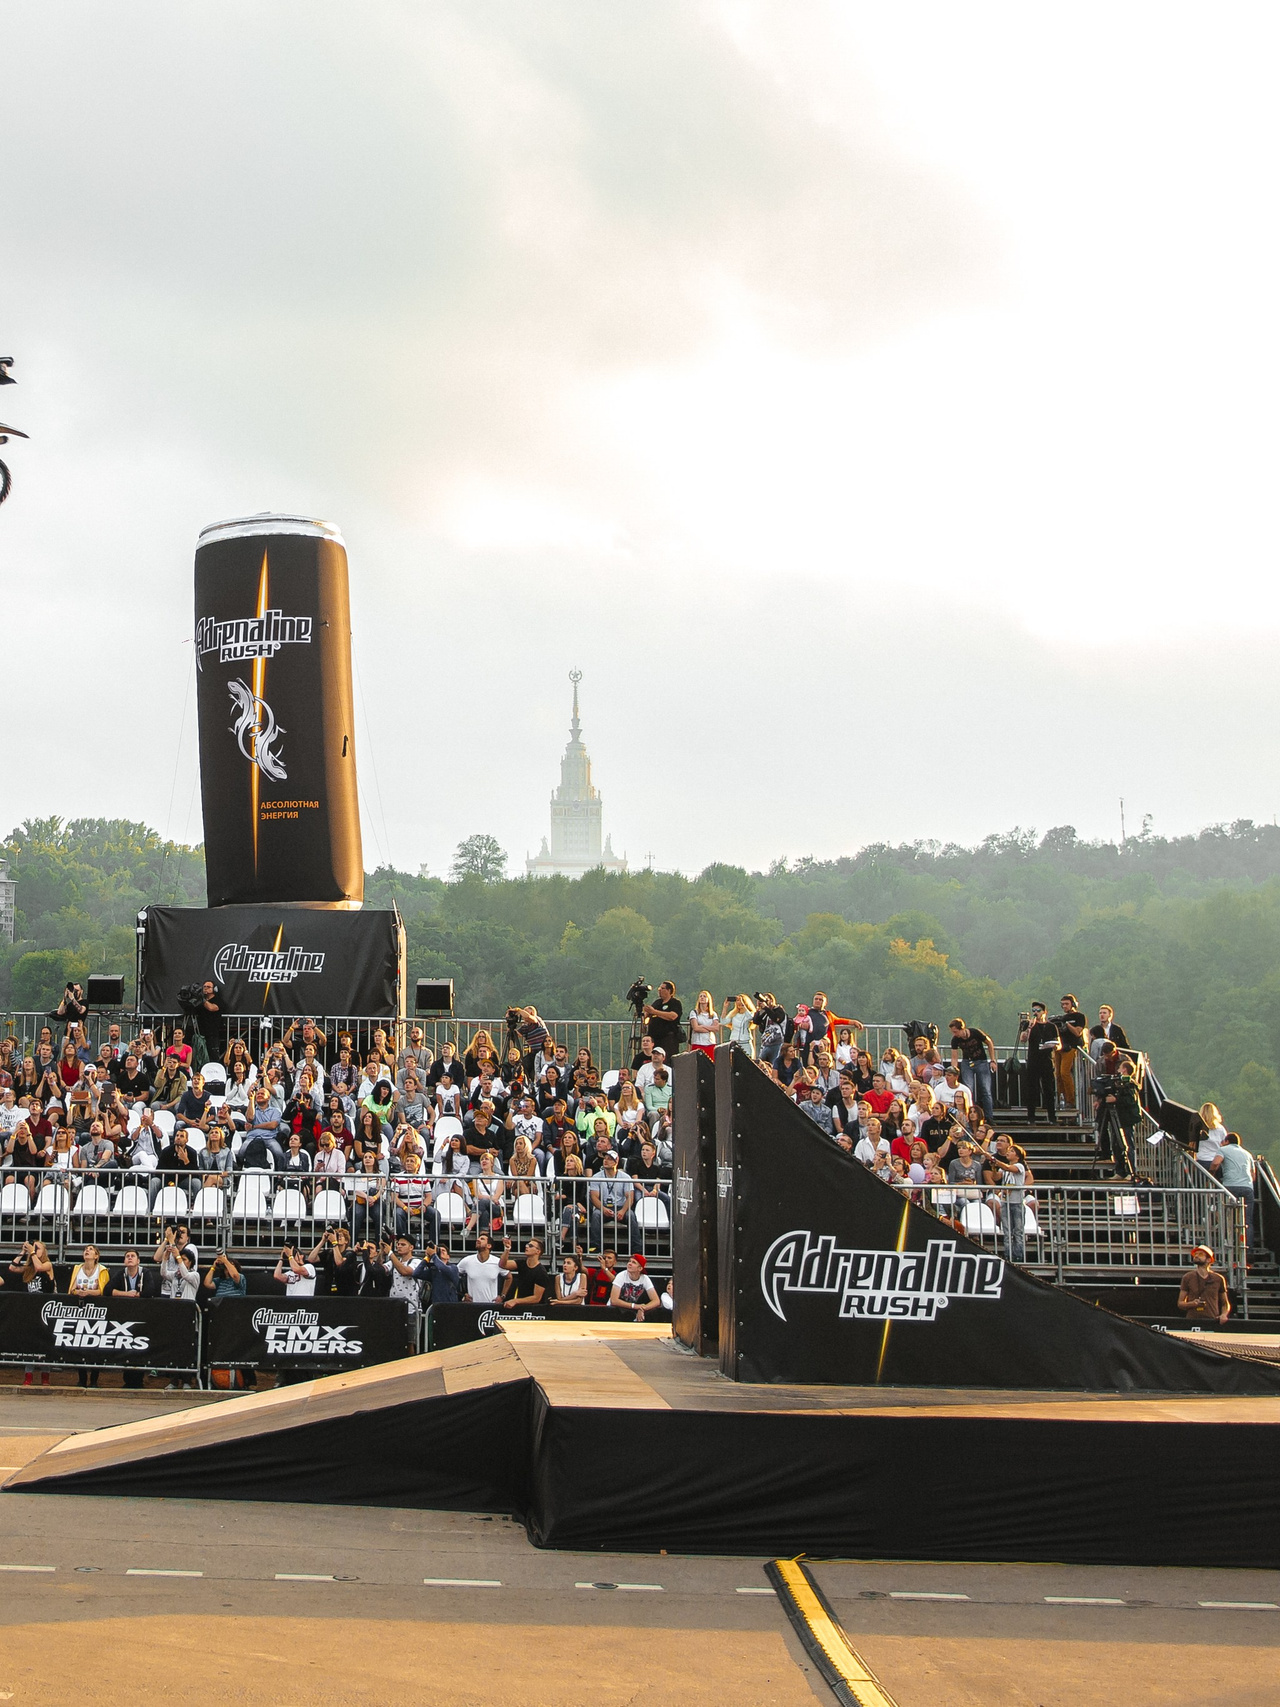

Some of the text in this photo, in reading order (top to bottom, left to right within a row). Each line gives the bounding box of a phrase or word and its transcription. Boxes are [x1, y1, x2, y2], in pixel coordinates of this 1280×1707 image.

[195, 609, 313, 672] Adrenaline
[260, 800, 320, 810] АБСОЛЮТНАЯ
[260, 811, 299, 821] ЭНЕРГИЯ
[214, 943, 325, 985] Adrenaline
[761, 1230, 1005, 1322] Adrenaline
[41, 1300, 108, 1326] Adrenaline
[251, 1307, 319, 1334] Adrenaline
[53, 1318, 147, 1336] FMX
[265, 1325, 359, 1340] FMX
[53, 1333, 150, 1350] RIDERS
[265, 1340, 363, 1354] RIDERS
